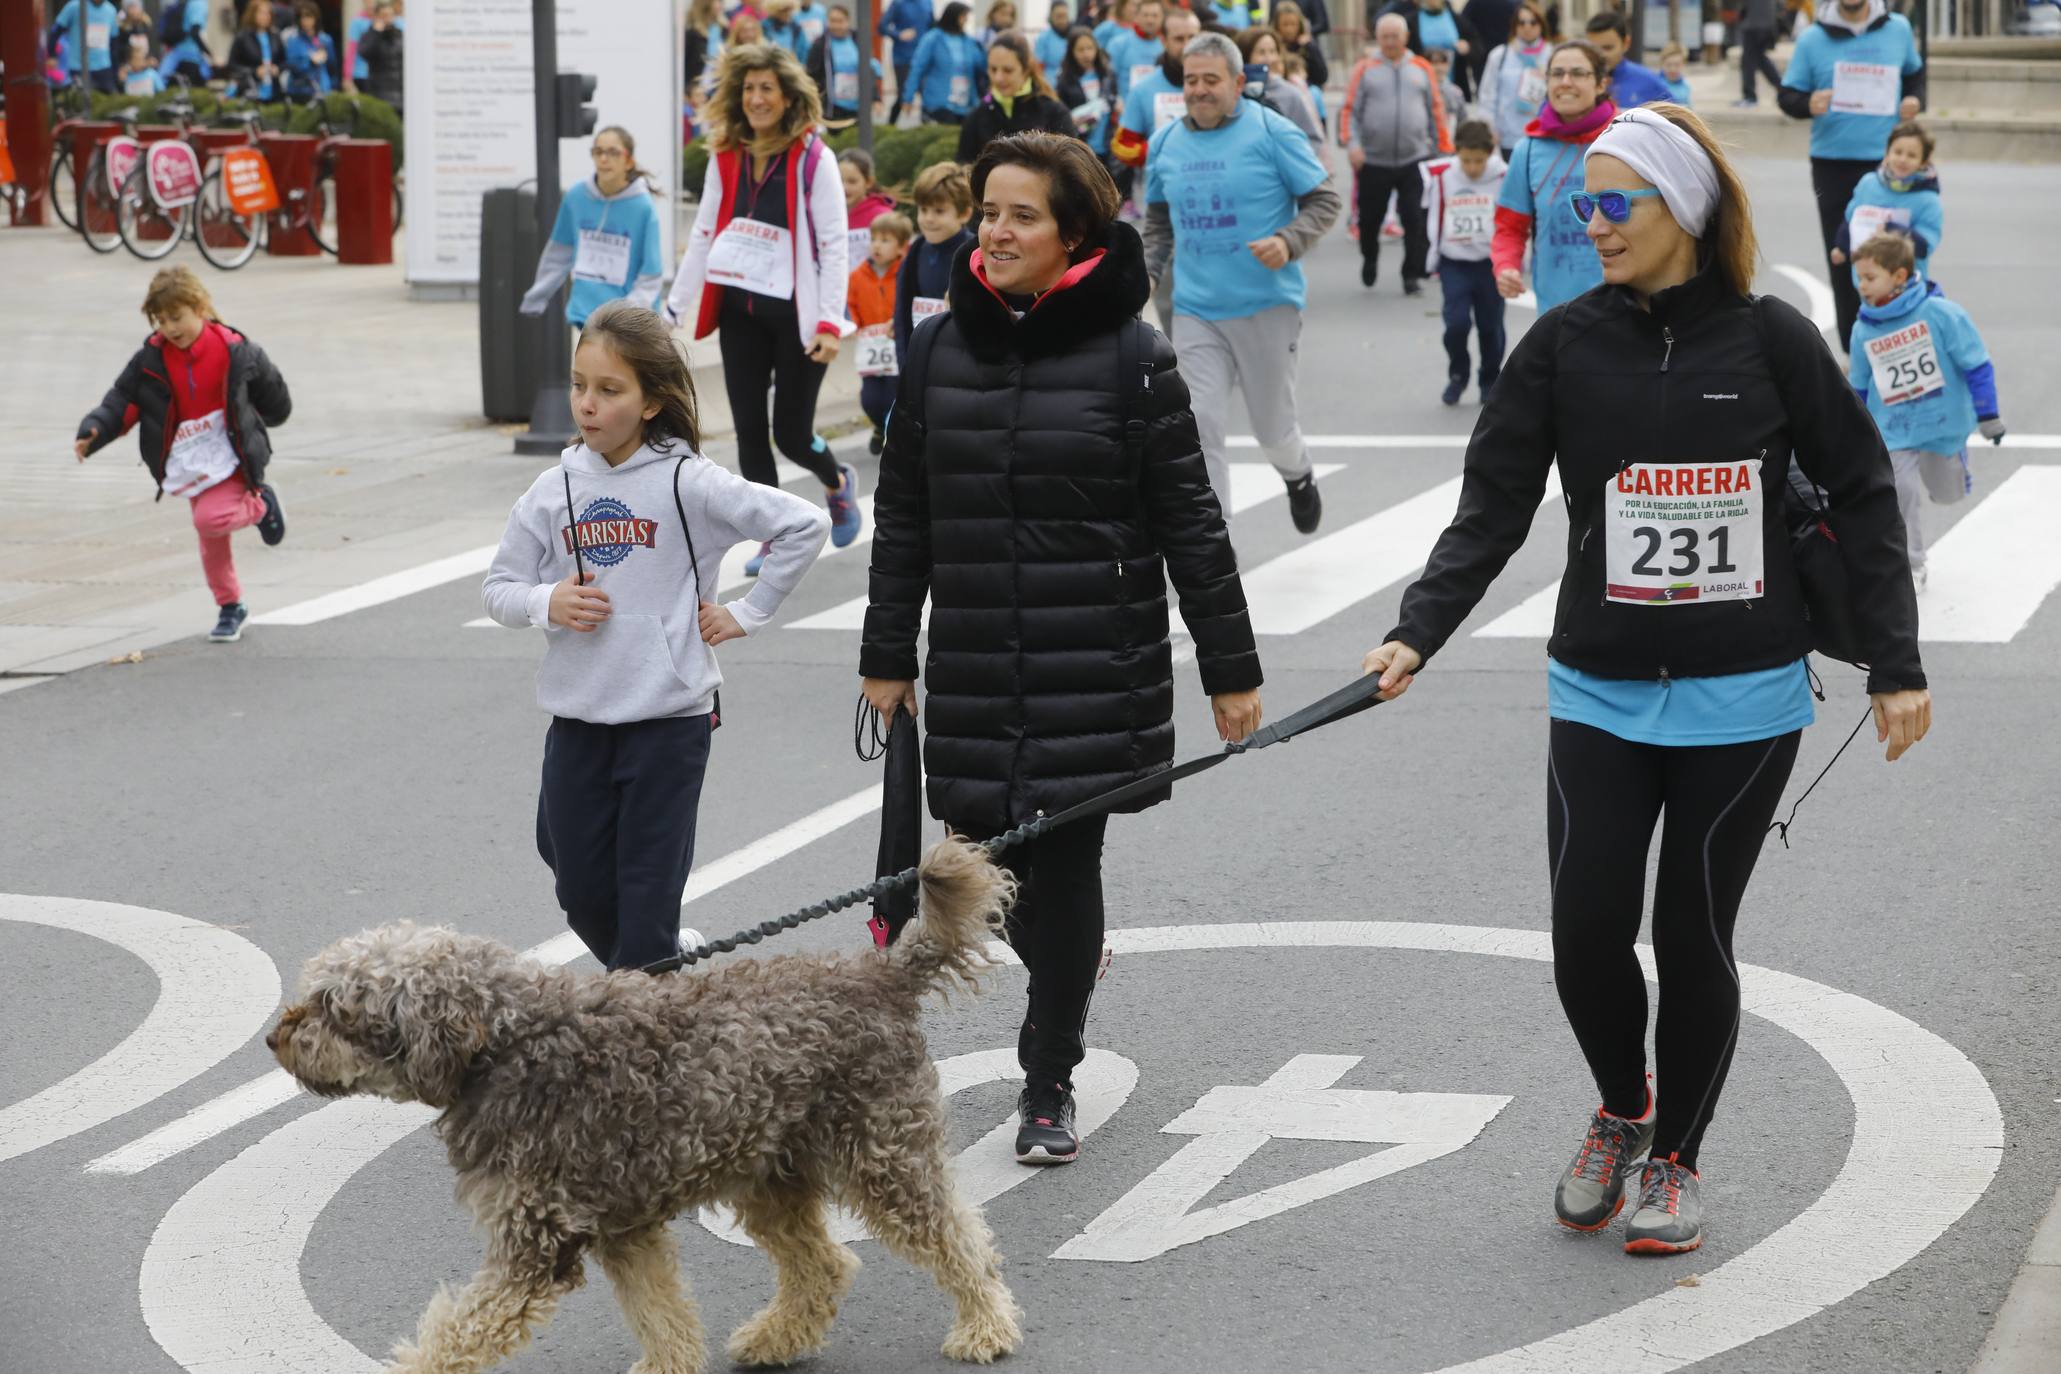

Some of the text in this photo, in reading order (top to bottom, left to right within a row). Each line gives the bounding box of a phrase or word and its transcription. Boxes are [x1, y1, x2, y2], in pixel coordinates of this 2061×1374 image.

[1454, 216, 1485, 235] 501
[1870, 323, 1928, 355] CARRERA
[1887, 352, 1935, 390] 256
[1617, 465, 1751, 496] CARRERA
[1618, 508, 1749, 521] Y LA VIDA SALUDABLE DE LA RIOJA
[1625, 498, 1744, 510] POR LA EDUCACIÓN, LA FAMILIA
[1631, 526, 1737, 577] 231
[1703, 582, 1749, 593] LABORAL
